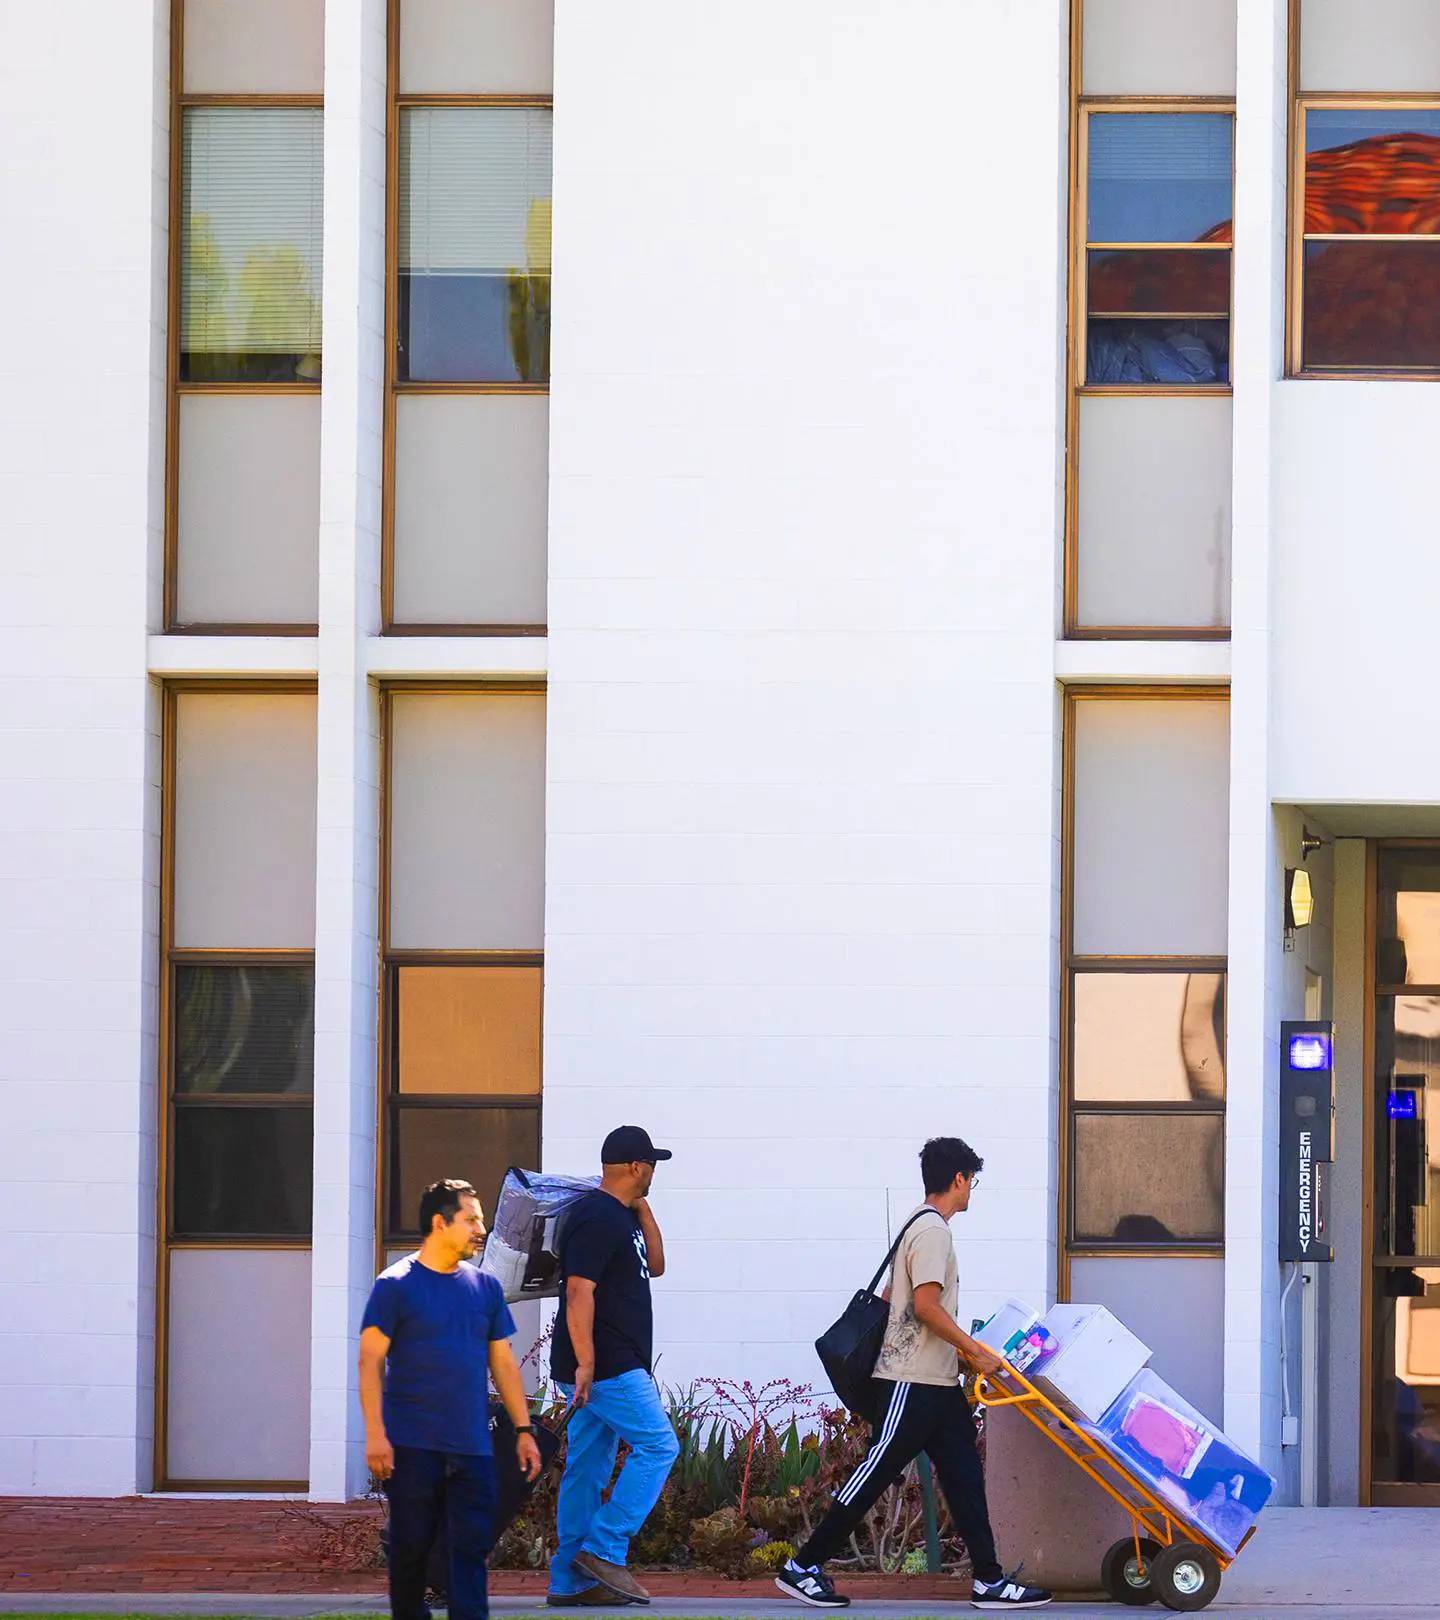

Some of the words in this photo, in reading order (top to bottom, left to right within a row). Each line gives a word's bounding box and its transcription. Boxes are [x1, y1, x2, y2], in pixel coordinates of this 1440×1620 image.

[1299, 1132, 1311, 1253] EMERGENCY
[797, 1576, 823, 1596] N
[1000, 1583, 1026, 1600] N
